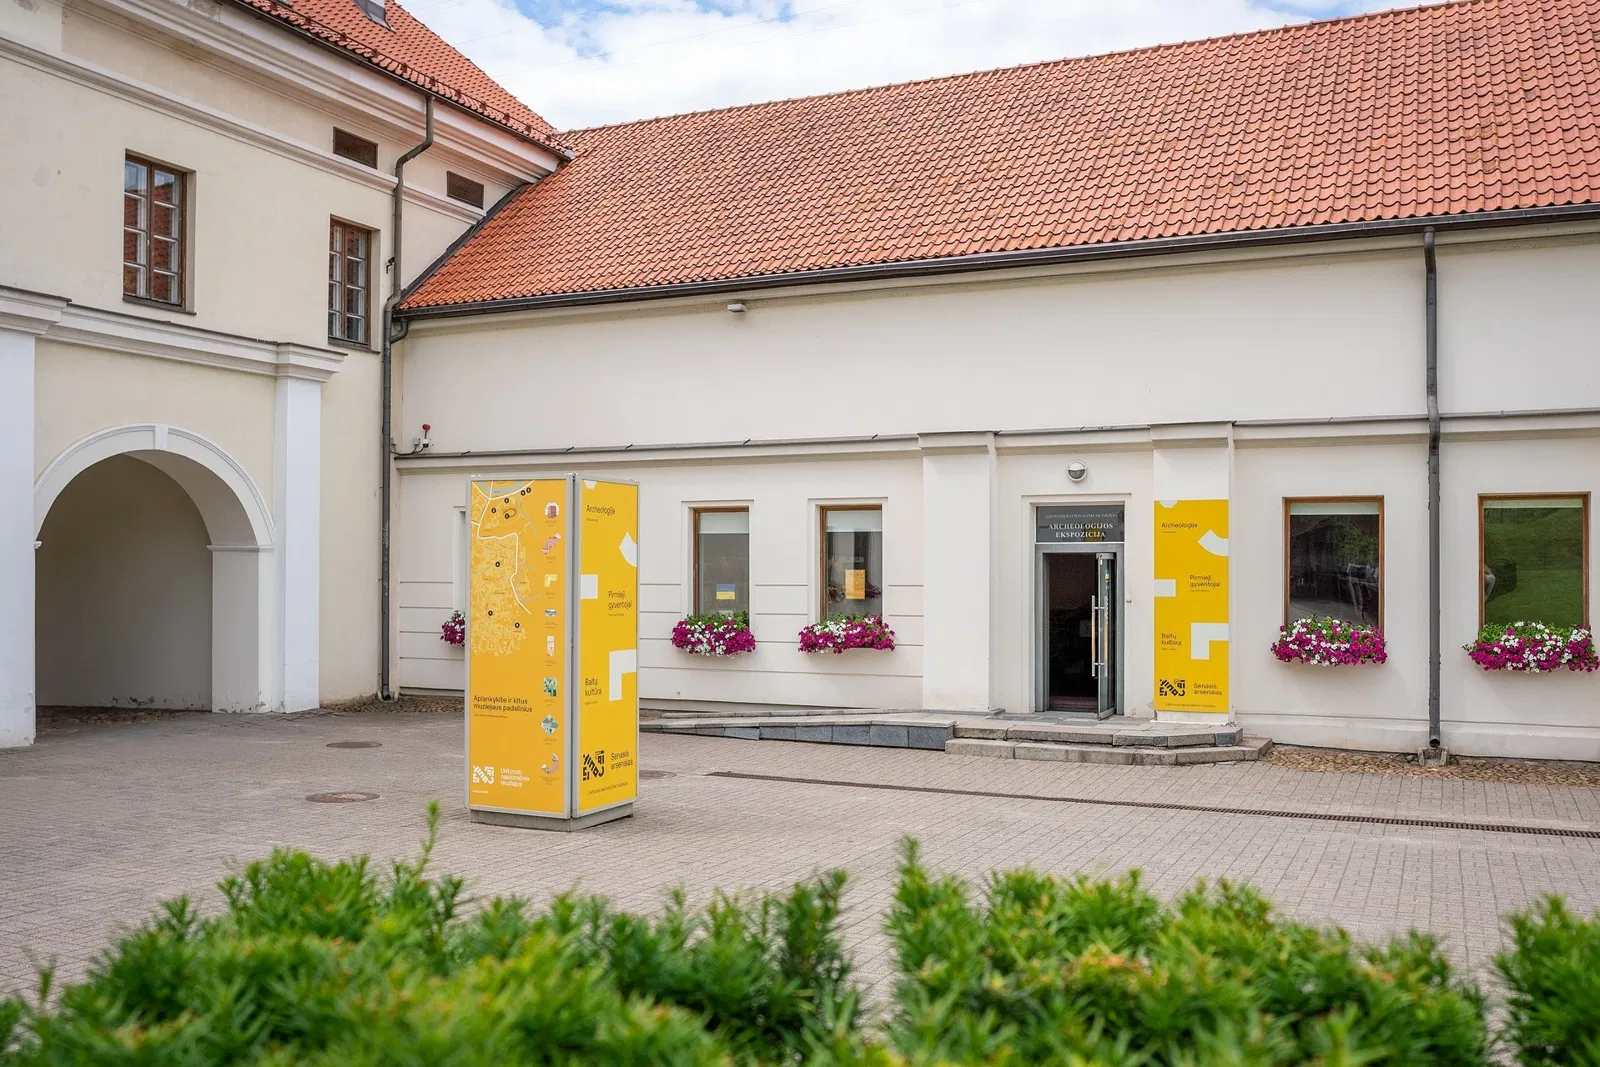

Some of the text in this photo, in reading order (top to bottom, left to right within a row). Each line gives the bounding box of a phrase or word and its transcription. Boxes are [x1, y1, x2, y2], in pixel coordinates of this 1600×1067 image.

[586, 504, 616, 516] Archeologija
[1048, 522, 1114, 530] ARCHEOLOGIJOS
[1189, 574, 1212, 582] Pirmieji
[1189, 581, 1221, 589] gyventojai
[608, 590, 626, 600] Pirmieji
[608, 600, 632, 611] gyventojai
[584, 678, 598, 687] Baltų
[584, 687, 602, 697] kultūra
[473, 695, 507, 704] Aplankykite
[513, 697, 528, 705] kitus
[473, 703, 533, 713] muziejaus padalinius
[610, 749, 630, 761] Senasis
[610, 758, 633, 770] arsenalas
[500, 774, 530, 782] nacionalinis
[500, 780, 523, 788] muziejus
